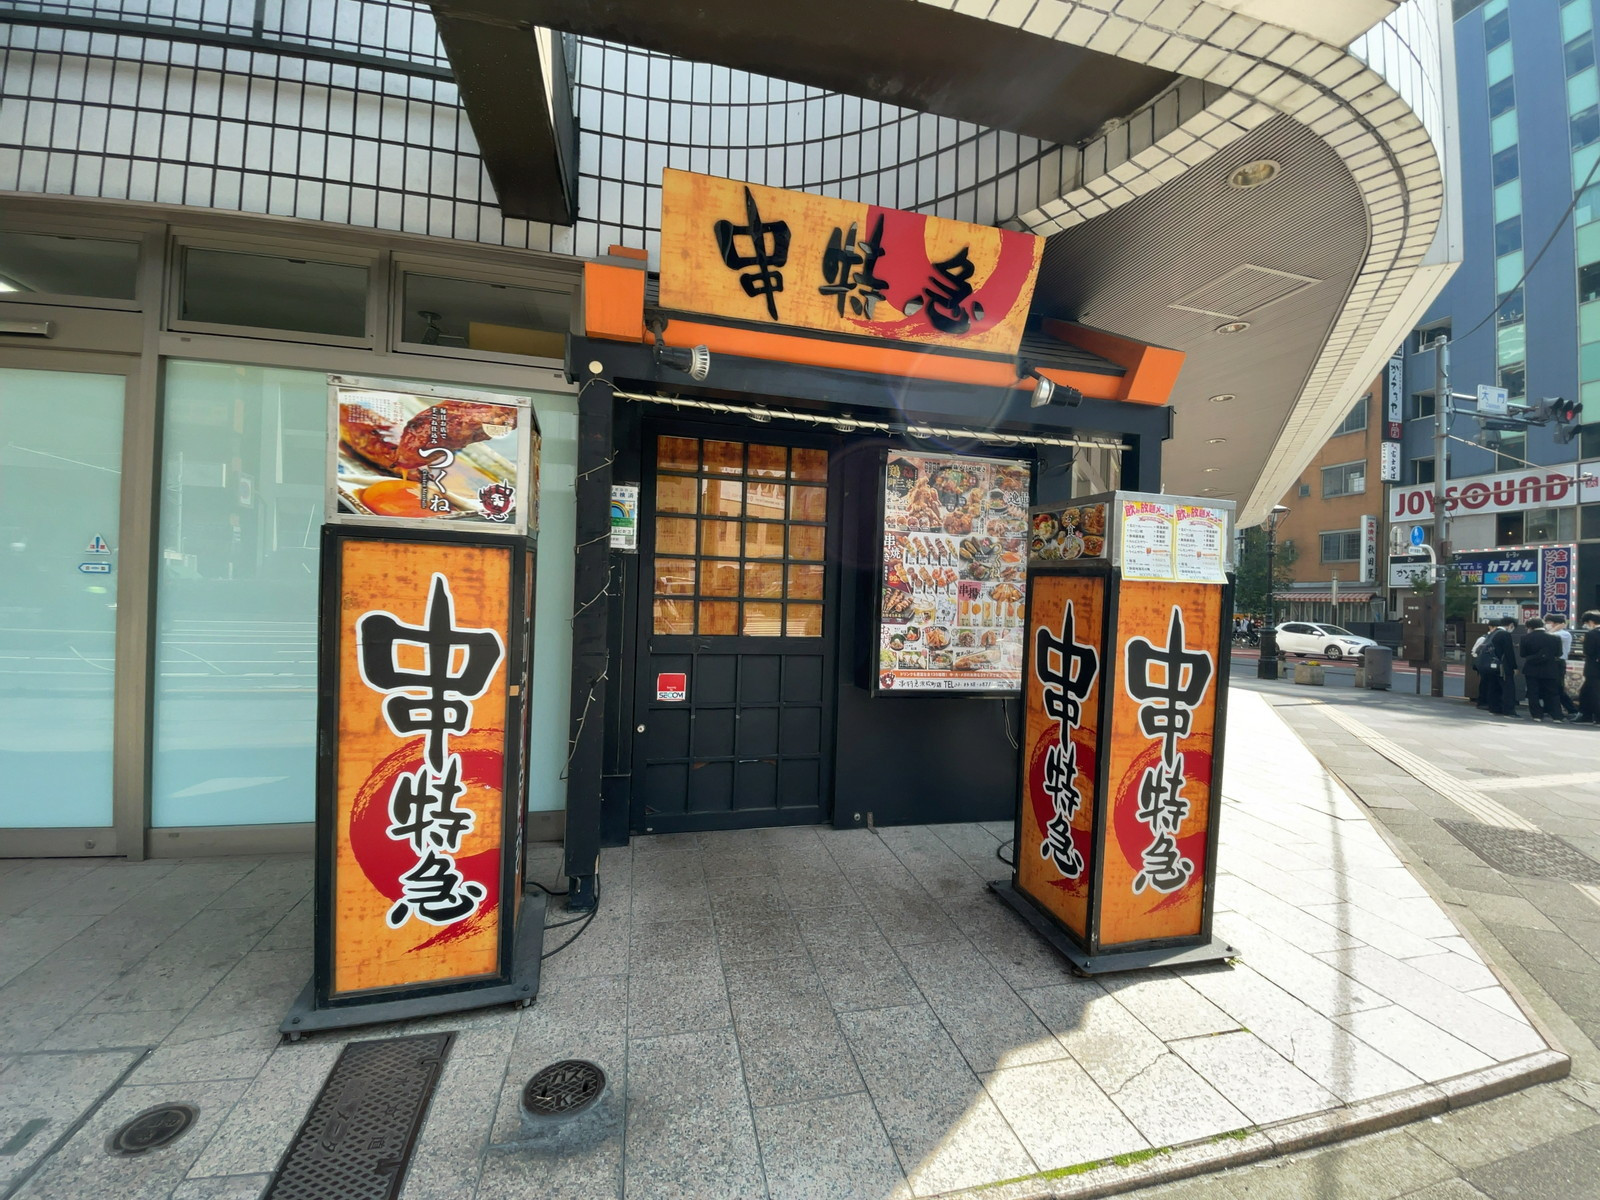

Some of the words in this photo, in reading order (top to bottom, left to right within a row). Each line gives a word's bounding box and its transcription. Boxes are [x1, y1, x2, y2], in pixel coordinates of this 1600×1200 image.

[714, 185, 985, 334] 串特急
[1481, 391, 1505, 404] 大門
[418, 447, 456, 512] つくね
[1394, 473, 1569, 516] JOYSOUND
[1487, 559, 1534, 572] カラオケ
[1555, 549, 1568, 612] 全時間帯
[943, 680, 954, 689] TEL
[356, 571, 505, 929] 串特急
[1035, 599, 1099, 879] 串特急
[1124, 604, 1214, 895] 串特急
